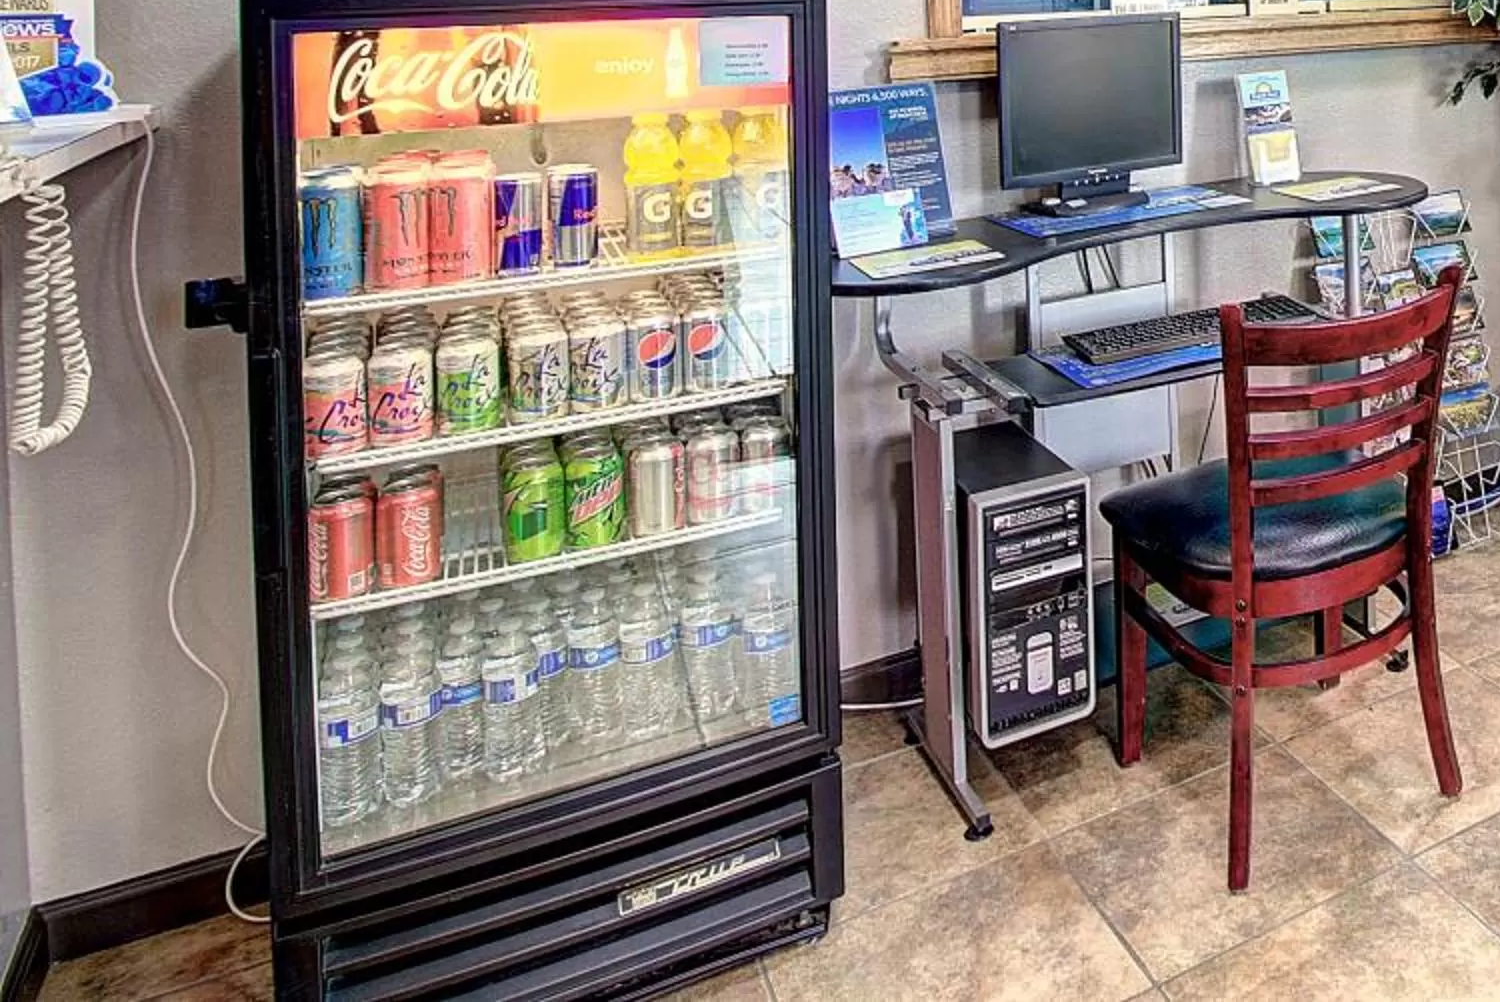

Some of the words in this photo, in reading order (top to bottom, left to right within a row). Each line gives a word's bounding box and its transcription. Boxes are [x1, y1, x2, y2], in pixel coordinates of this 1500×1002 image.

[327, 32, 541, 124] Coca-Cola
[594, 55, 656, 76] enjoy
[643, 192, 671, 223] G
[685, 189, 713, 219] G
